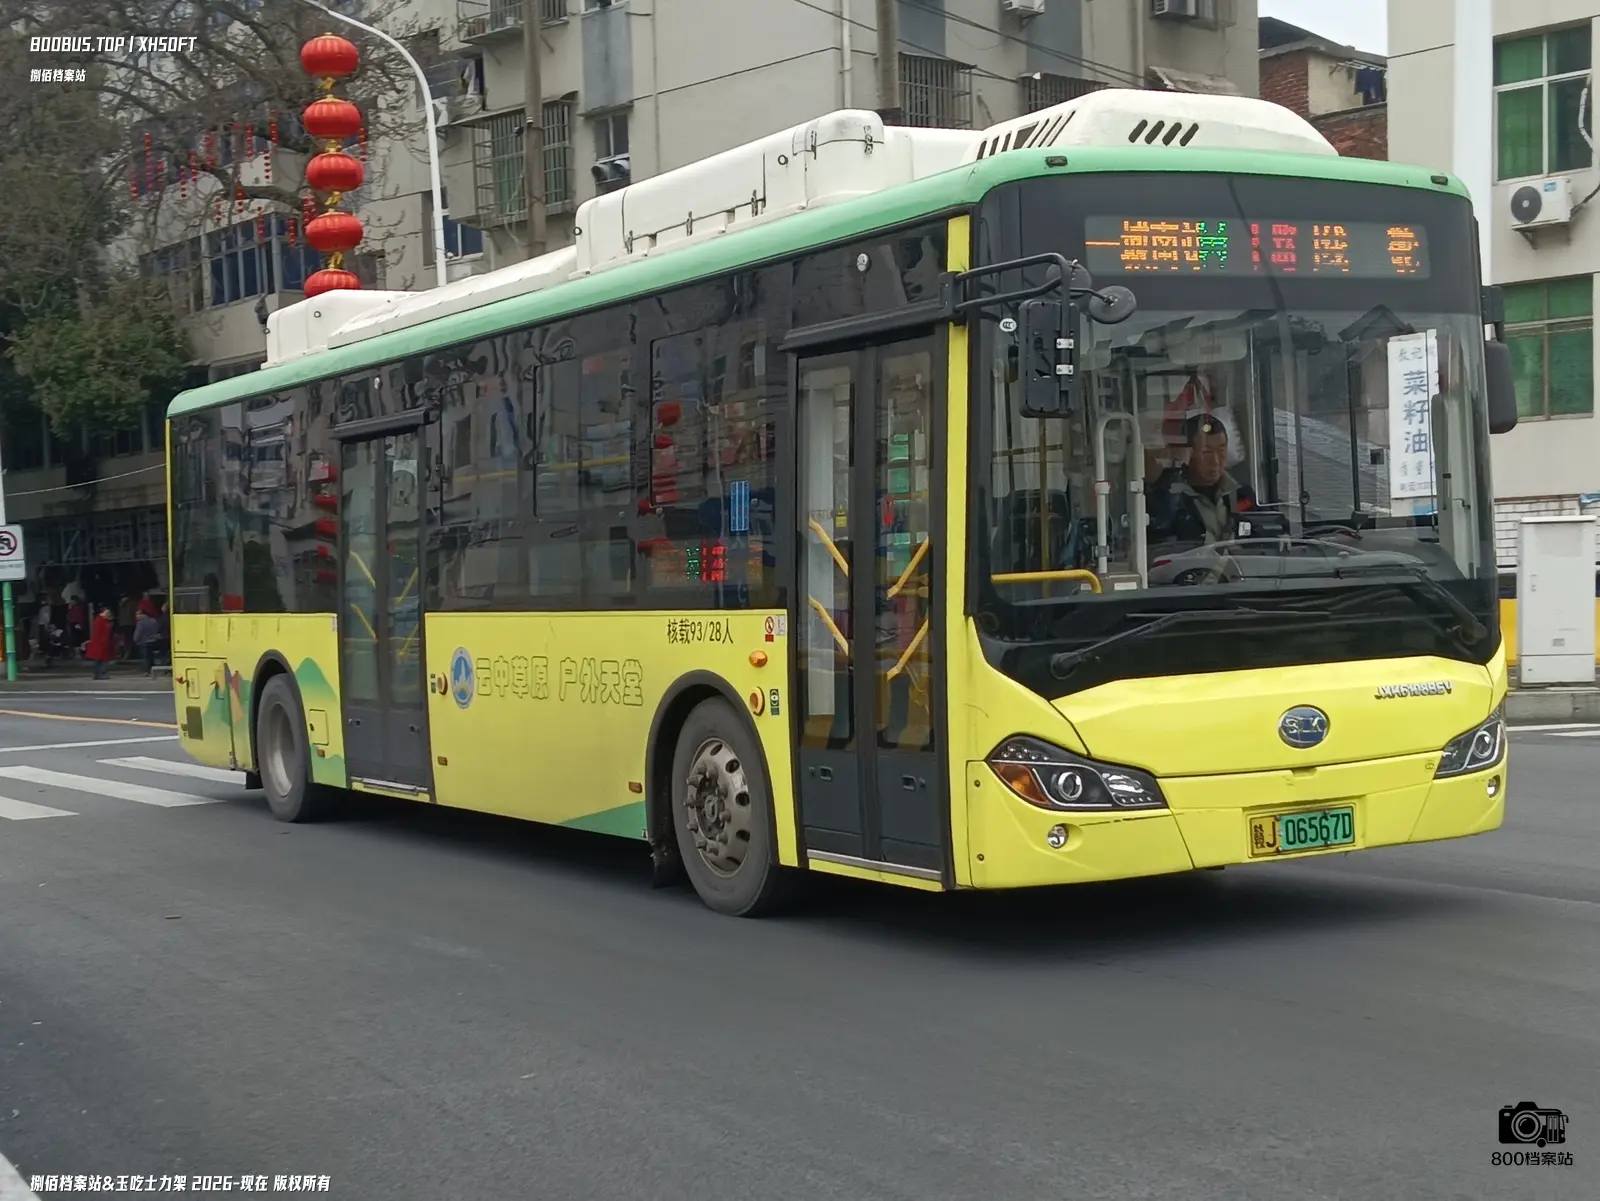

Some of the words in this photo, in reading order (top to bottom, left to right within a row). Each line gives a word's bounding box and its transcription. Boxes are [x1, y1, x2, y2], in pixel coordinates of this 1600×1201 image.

[1403, 369, 1429, 454] 菜籽油
[667, 618, 734, 644] 核载93/28人
[476, 655, 548, 700] 云中草原
[559, 656, 643, 707] 户外天堂
